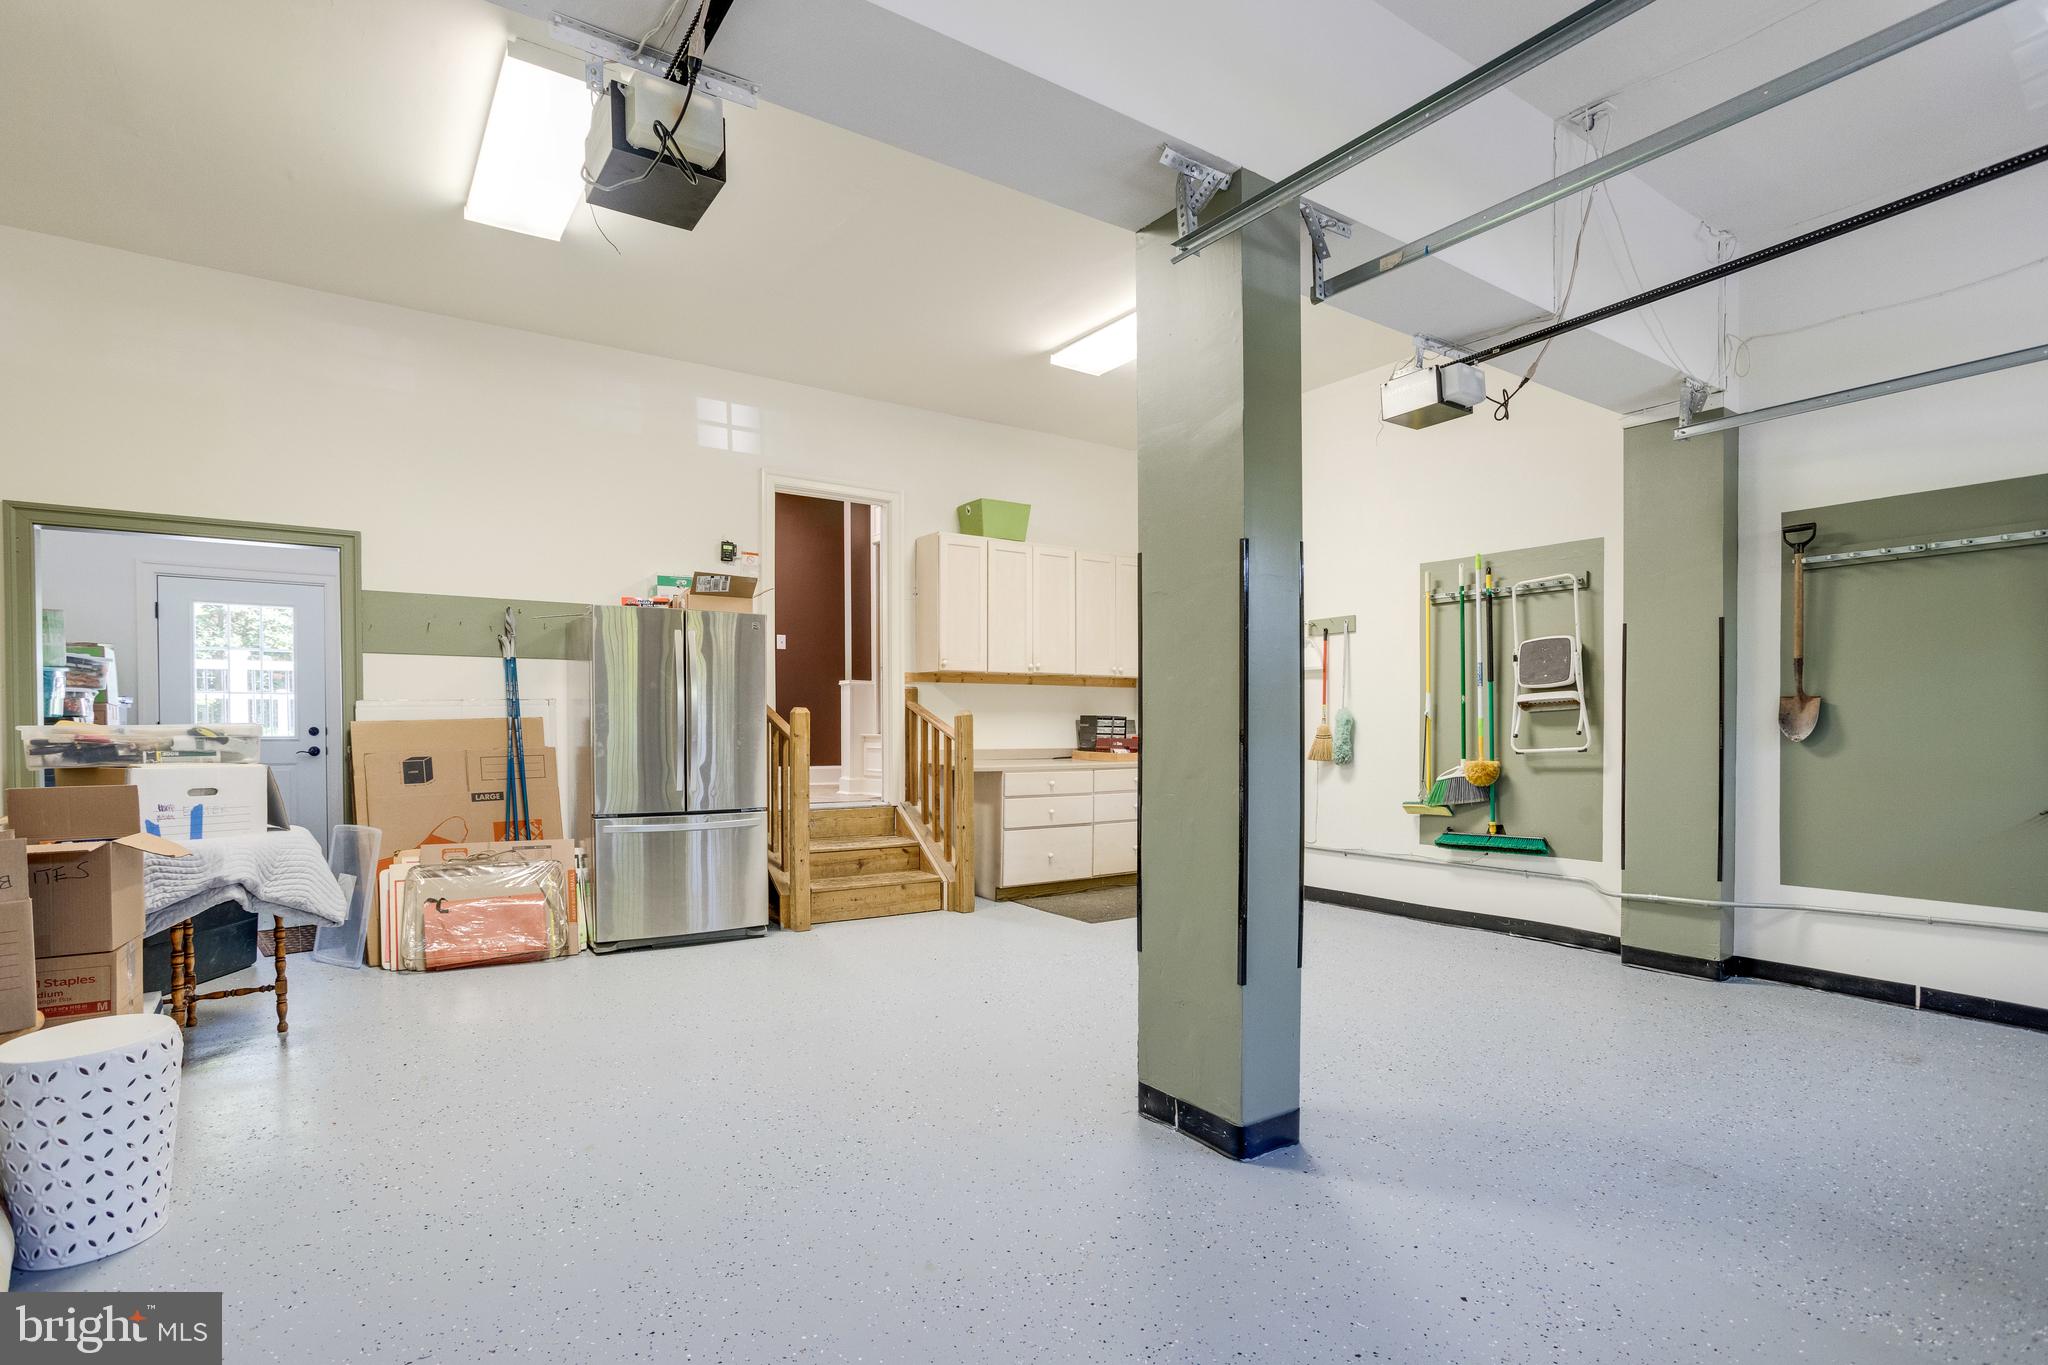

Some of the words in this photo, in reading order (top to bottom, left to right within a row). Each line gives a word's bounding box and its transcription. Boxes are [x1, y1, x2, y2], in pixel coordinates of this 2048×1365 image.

[475, 793, 501, 801] LARGE
[44, 976, 96, 988] Staples
[37, 990, 64, 999] dium
[97, 1002, 108, 1011] M
